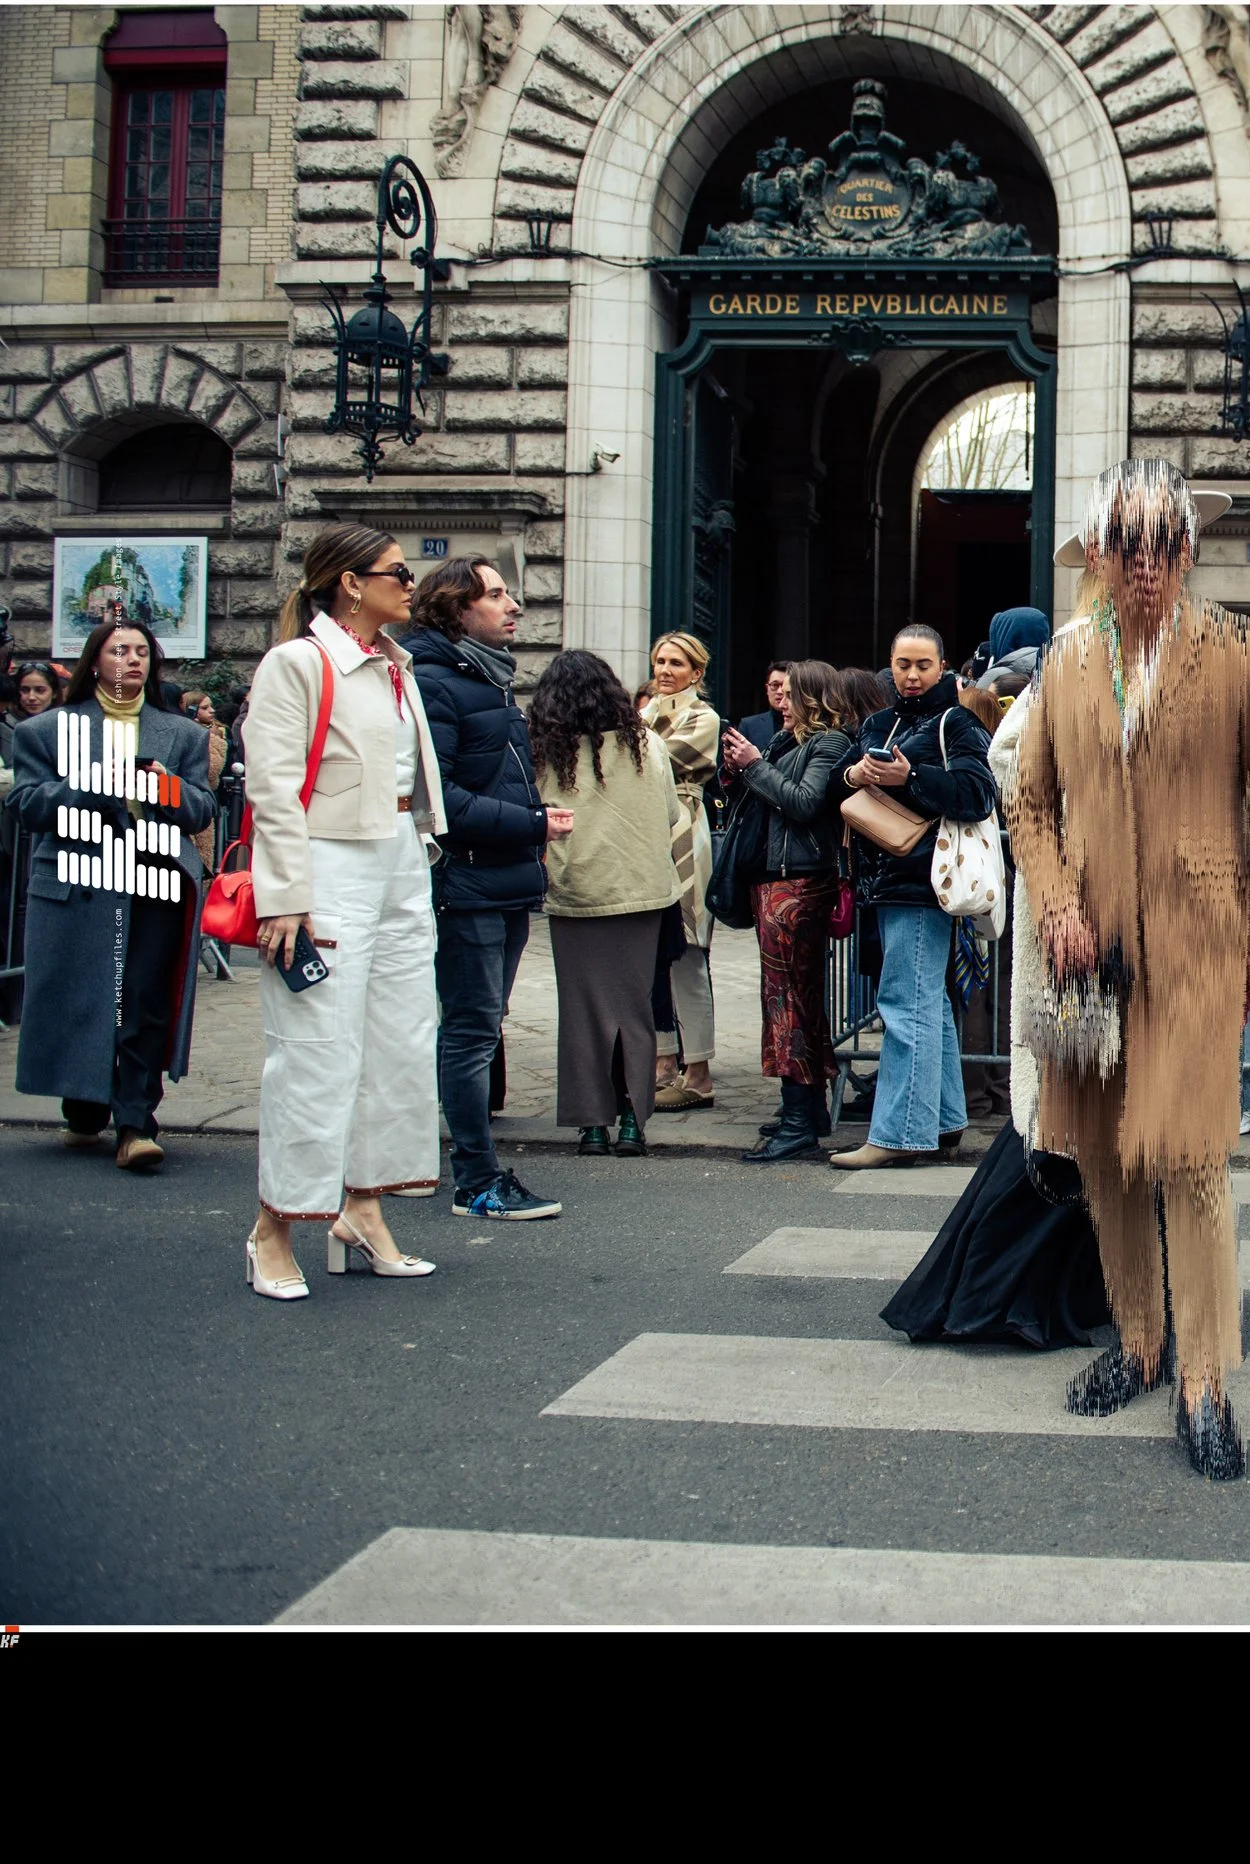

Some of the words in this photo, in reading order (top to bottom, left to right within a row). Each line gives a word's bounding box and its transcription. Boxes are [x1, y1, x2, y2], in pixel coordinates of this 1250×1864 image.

[855, 192, 874, 203] DES
[832, 204, 901, 221] CELESTINS
[708, 294, 800, 315] GARDE
[815, 293, 1008, 315] REPVBLICAINE
[426, 540, 445, 556] 20
